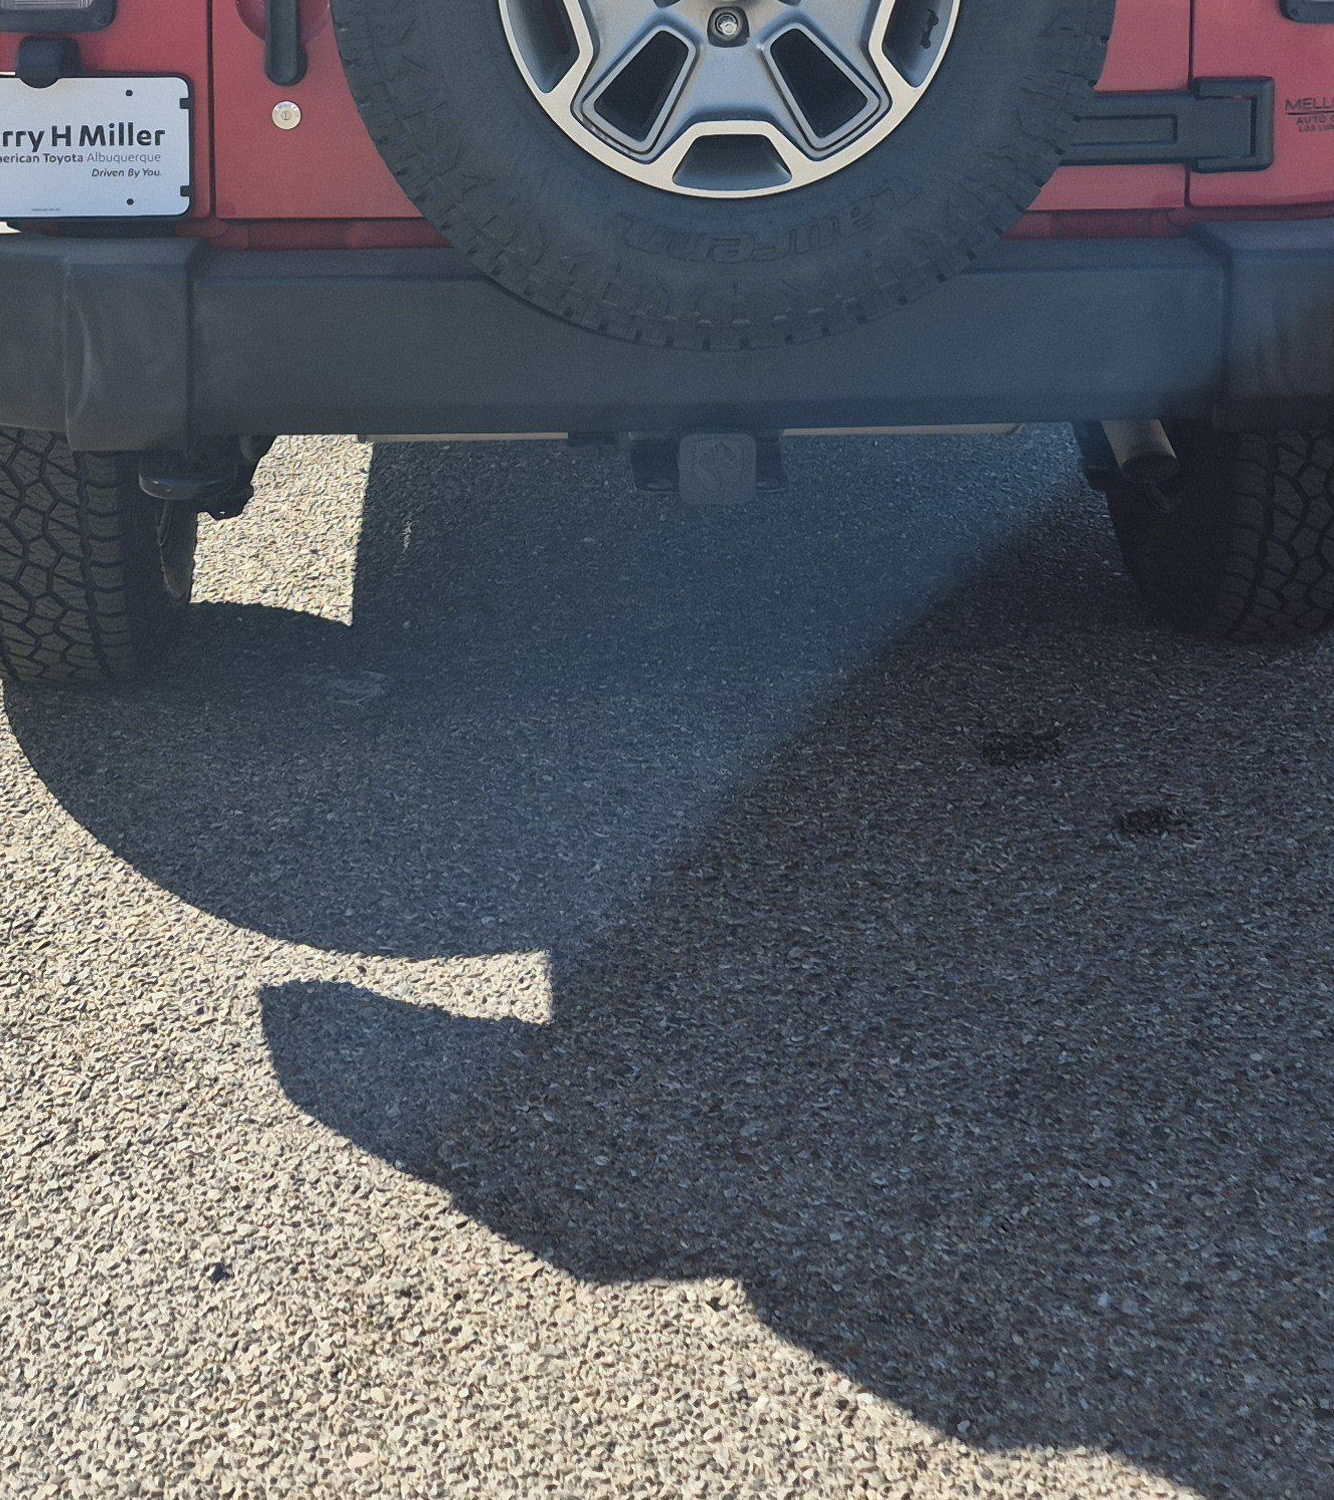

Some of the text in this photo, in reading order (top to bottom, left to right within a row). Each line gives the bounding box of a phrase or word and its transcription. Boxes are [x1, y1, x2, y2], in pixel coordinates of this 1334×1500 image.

[51, 125, 72, 147] H
[79, 121, 166, 147] Miller
[43, 152, 84, 166] Toyota
[86, 151, 161, 166] Albuquerque
[91, 167, 125, 177] Driven
[127, 167, 140, 179] By
